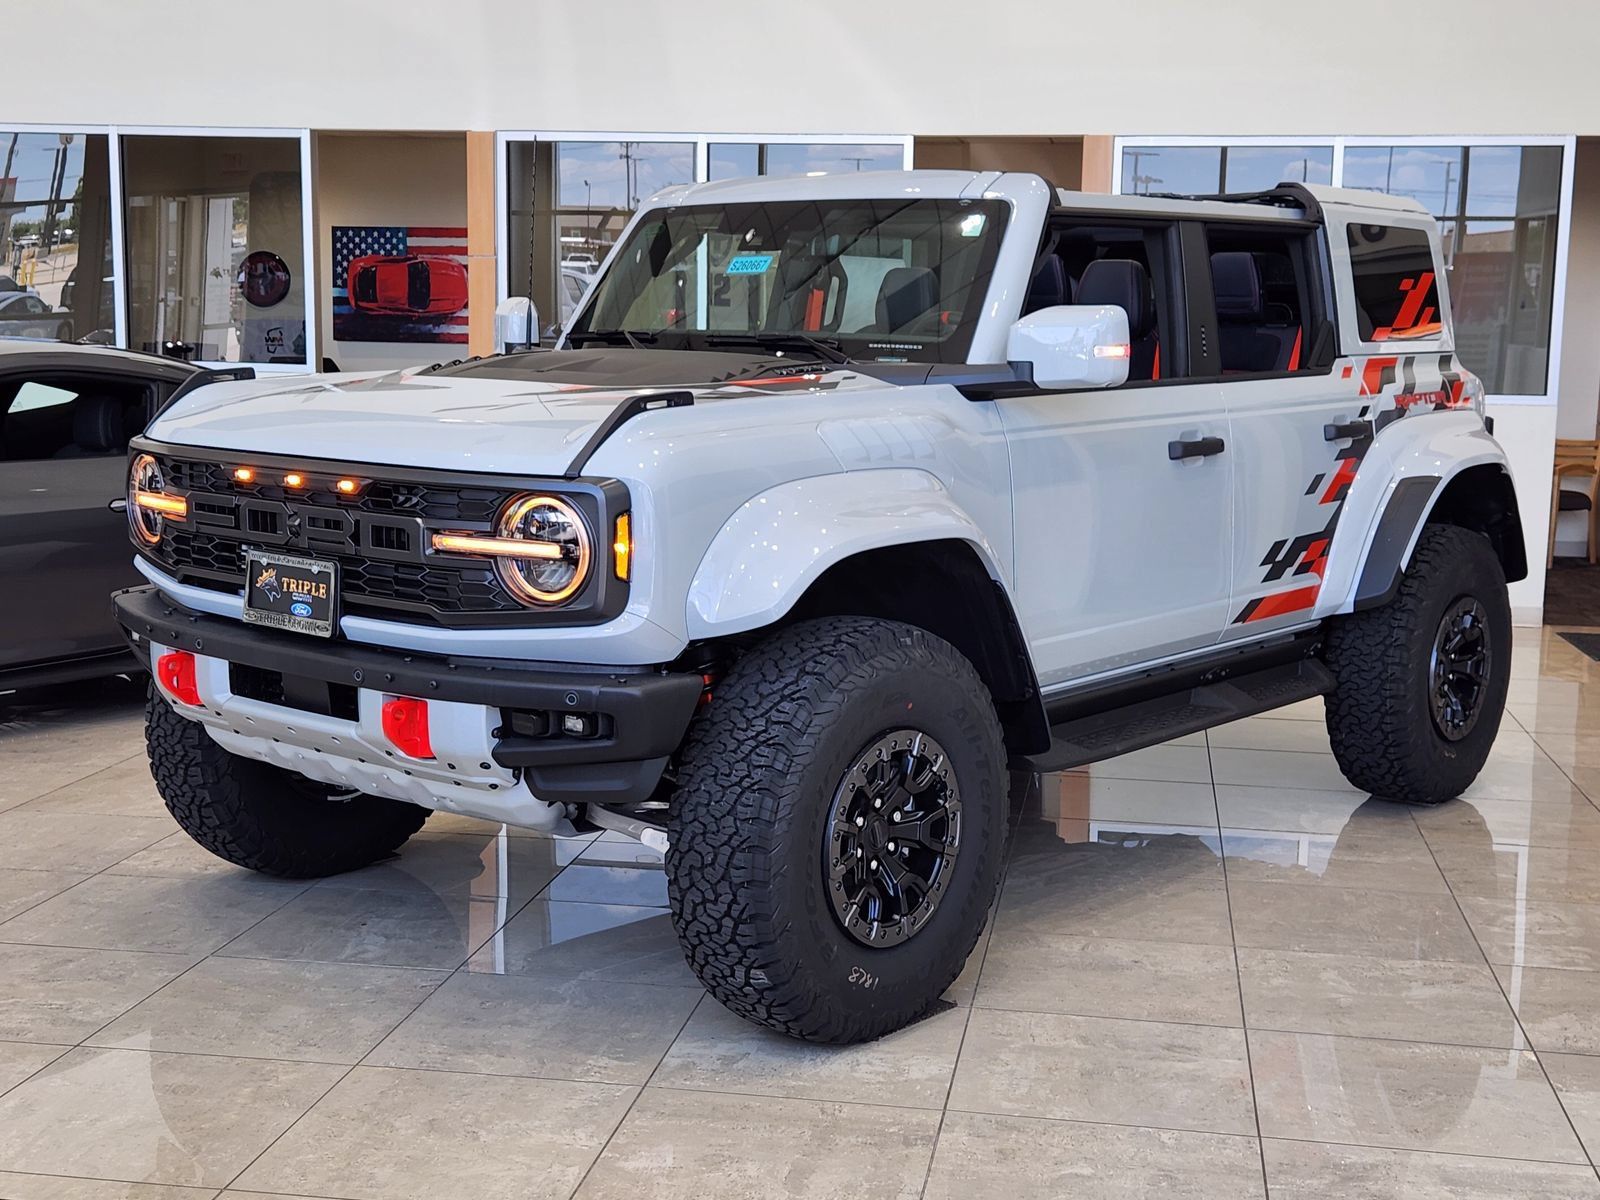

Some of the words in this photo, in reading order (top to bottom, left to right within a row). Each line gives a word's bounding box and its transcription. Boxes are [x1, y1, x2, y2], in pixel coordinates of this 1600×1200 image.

[730, 260, 768, 272] S260667
[1393, 391, 1447, 412] RAPTOR
[186, 491, 425, 564] FORD
[281, 577, 327, 599] TRIPLE
[257, 612, 288, 627] TRIPLE
